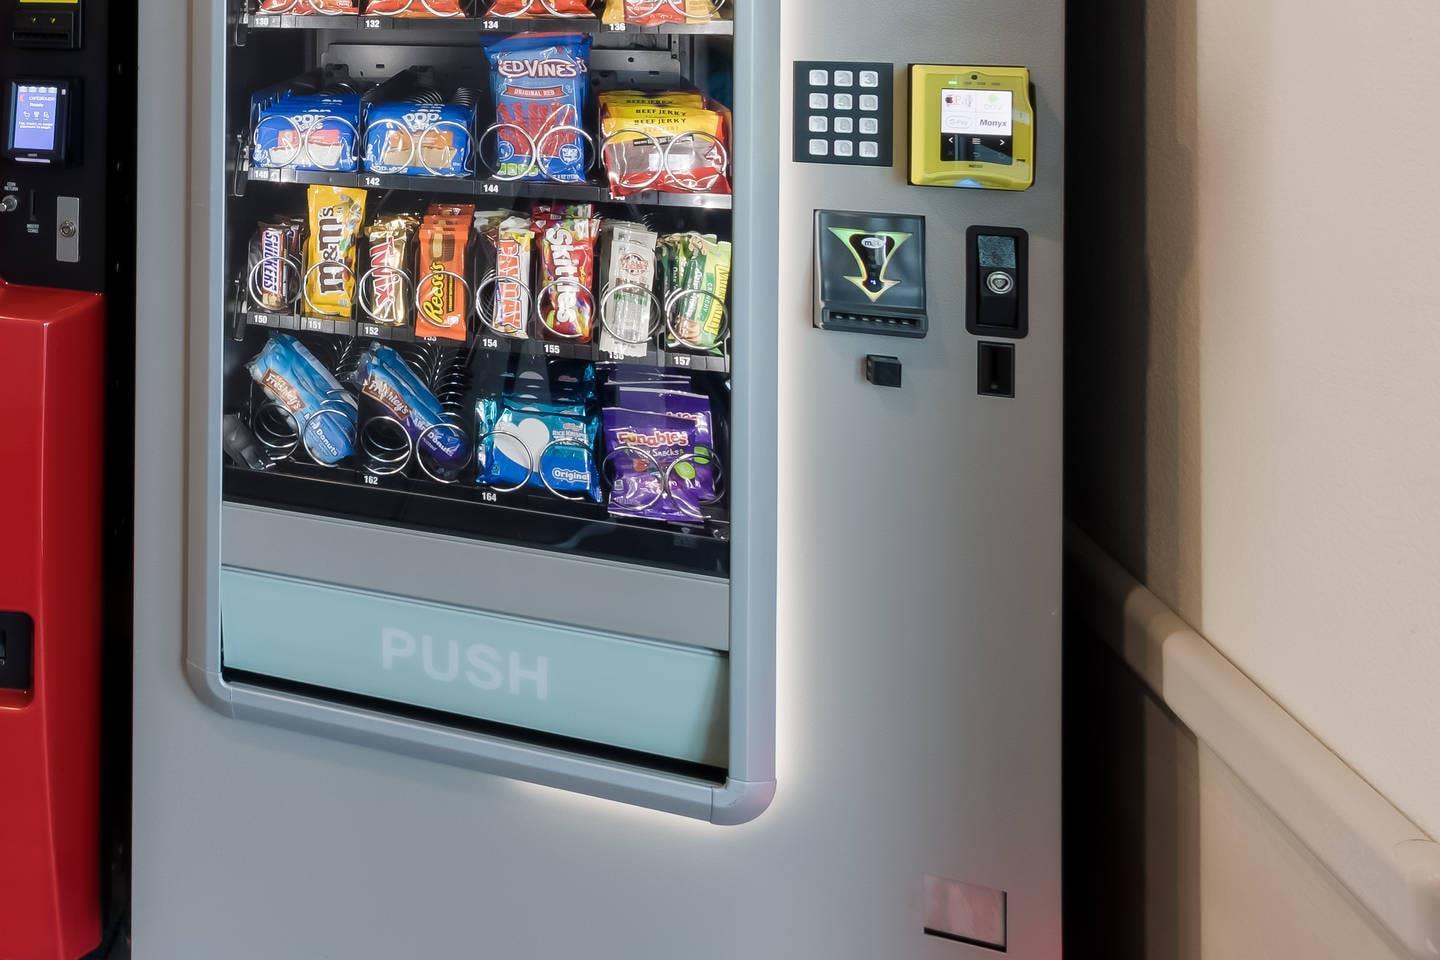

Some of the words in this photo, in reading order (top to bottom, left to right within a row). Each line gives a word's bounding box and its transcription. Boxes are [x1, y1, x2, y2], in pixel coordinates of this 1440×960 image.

[365, 20, 380, 28] 132
[483, 21, 499, 29] 134
[610, 23, 626, 31] 136
[980, 119, 1007, 128] Monyx
[365, 178, 380, 186] 142
[483, 184, 499, 193] 144
[545, 228, 577, 323] Skittles
[254, 315, 267, 323] 150
[308, 321, 321, 329] 151
[365, 327, 379, 335] 152
[482, 339, 497, 348] 154
[545, 345, 560, 354] 155
[674, 357, 690, 366] 157
[266, 373, 302, 410] Freshley's
[316, 425, 338, 457] Donuts
[617, 431, 688, 446] Funables
[427, 431, 453, 457] Donuts
[652, 448, 679, 456] Snacks
[553, 469, 590, 481] Original
[364, 476, 378, 485] 162
[482, 492, 497, 501] 164
[381, 626, 548, 701] PUSH
